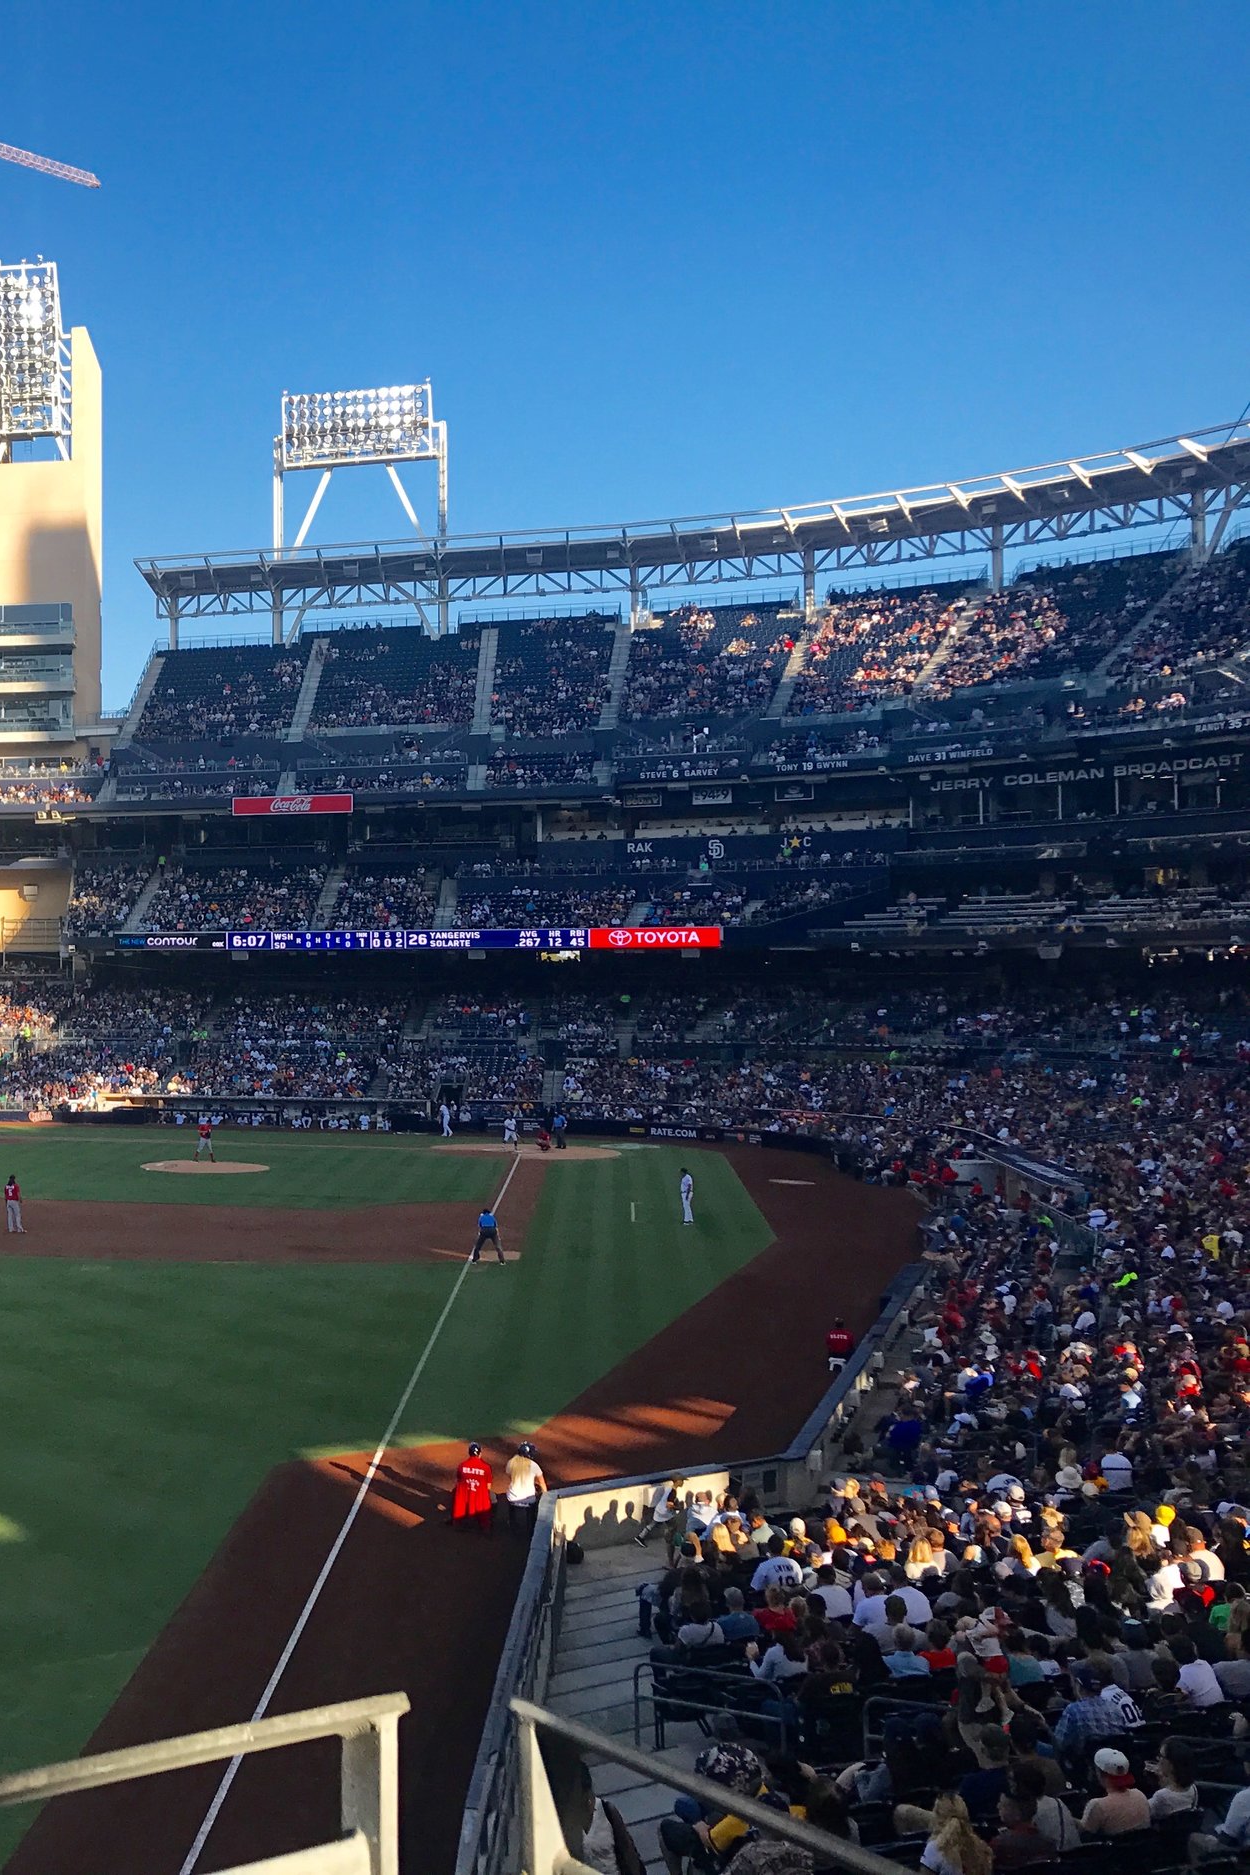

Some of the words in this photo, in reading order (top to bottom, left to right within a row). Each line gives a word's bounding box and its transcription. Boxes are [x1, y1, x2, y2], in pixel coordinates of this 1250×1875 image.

[1229, 718, 1243, 729] 35
[908, 753, 932, 763] DAVE
[934, 751, 947, 761] 31
[949, 748, 994, 760] WINFIELD
[776, 763, 799, 772] TONY
[802, 761, 814, 771] 19
[816, 760, 849, 770] GWYNN
[640, 771, 668, 779] STEVE
[672, 769, 680, 779] 6
[684, 768, 719, 777] GARVEY
[930, 776, 995, 792] JERRY
[1003, 767, 1105, 787] COLEMAN
[1113, 752, 1245, 777] BROADCAST
[270, 798, 314, 812] Coca-Cola
[627, 842, 653, 854] RAK
[780, 836, 788, 849] J
[803, 835, 812, 847] C
[408, 933, 428, 946] 26
[430, 931, 481, 939] YANGERVIS
[519, 930, 538, 938] AVG
[549, 930, 561, 938] HR
[569, 929, 585, 937] RBI
[634, 931, 701, 943] TOYOTA
[232, 935, 267, 947] 6:07
[274, 941, 286, 949] SD
[360, 938, 365, 948] 1
[373, 939, 381, 947] 0
[384, 939, 392, 947] 0
[395, 939, 403, 948] 2
[430, 939, 471, 947] SOLARTE
[515, 938, 541, 947] .267
[548, 938, 562, 947] 12
[569, 938, 585, 946] 45
[651, 1128, 697, 1138] RATE.COM
[462, 1466, 486, 1476] ELITE
